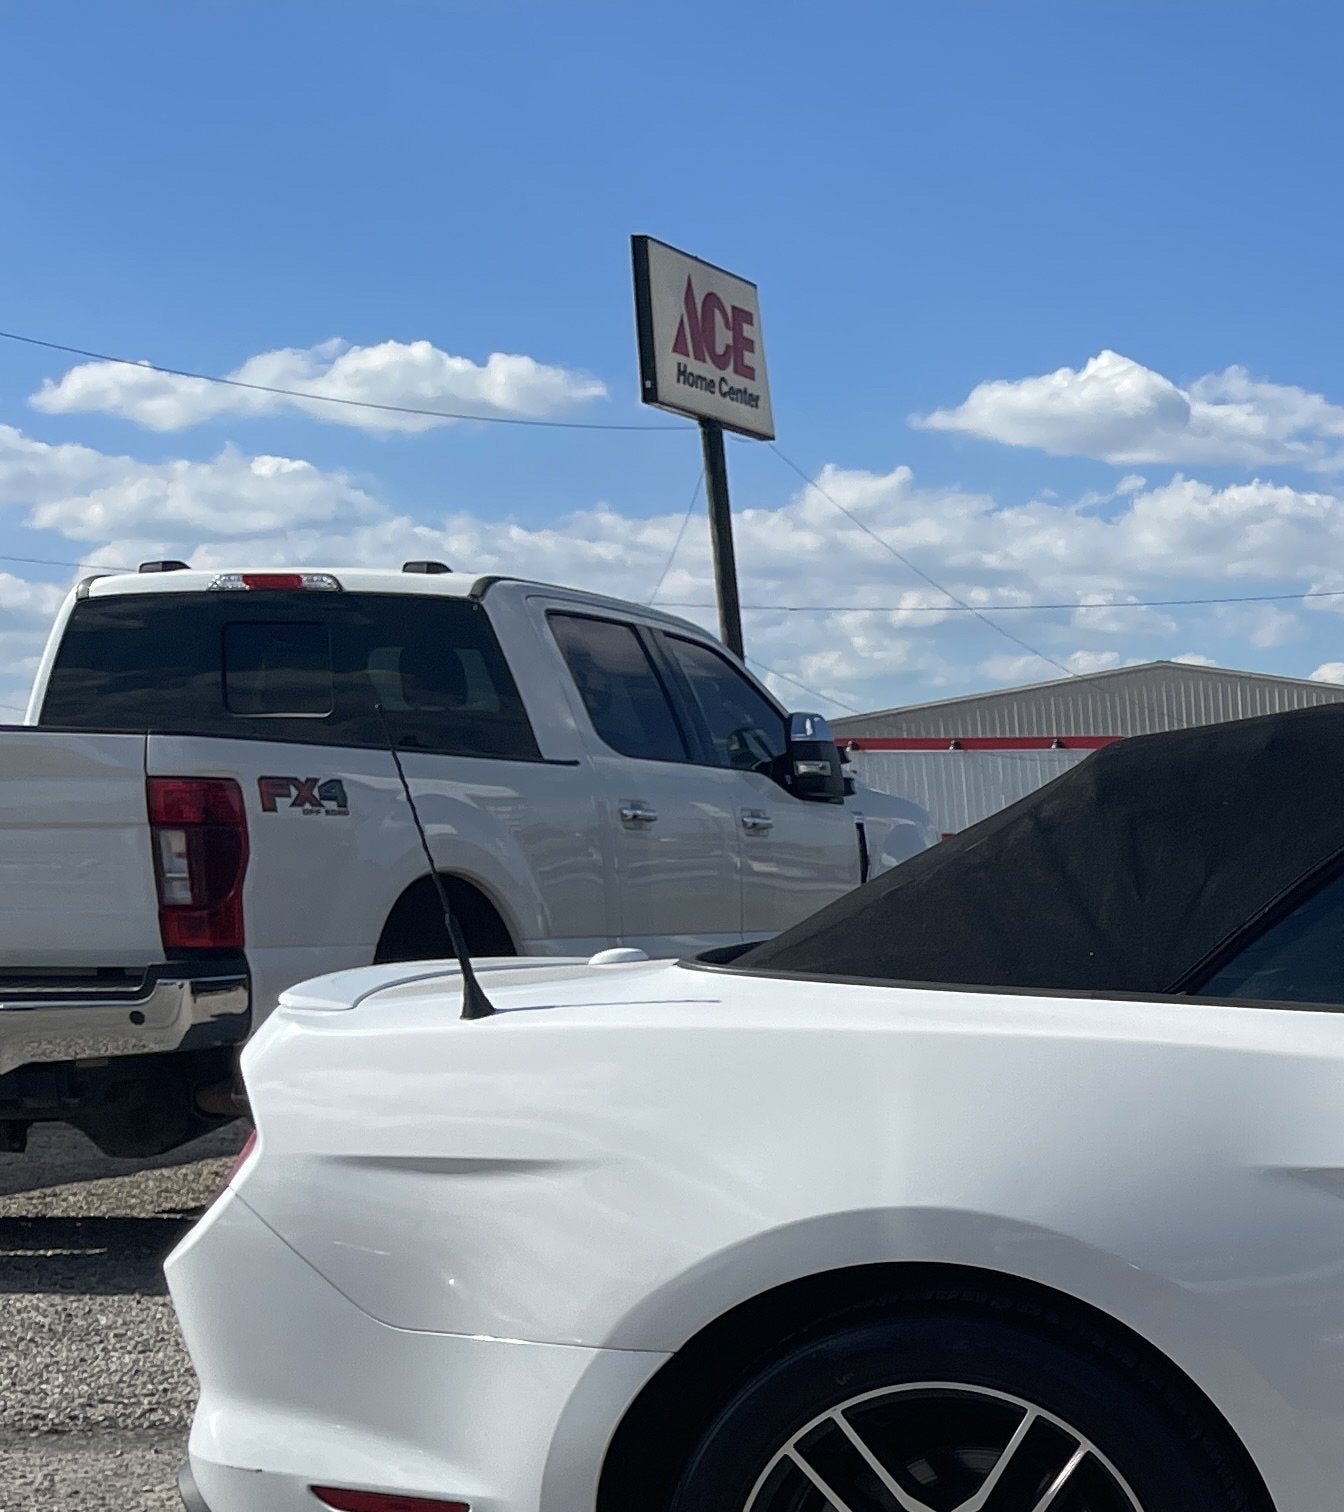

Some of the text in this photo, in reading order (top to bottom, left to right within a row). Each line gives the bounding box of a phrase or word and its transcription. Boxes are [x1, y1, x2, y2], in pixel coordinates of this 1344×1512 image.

[672, 272, 755, 381] ACE
[677, 362, 760, 409] Home Center
[257, 776, 348, 812] FX4
